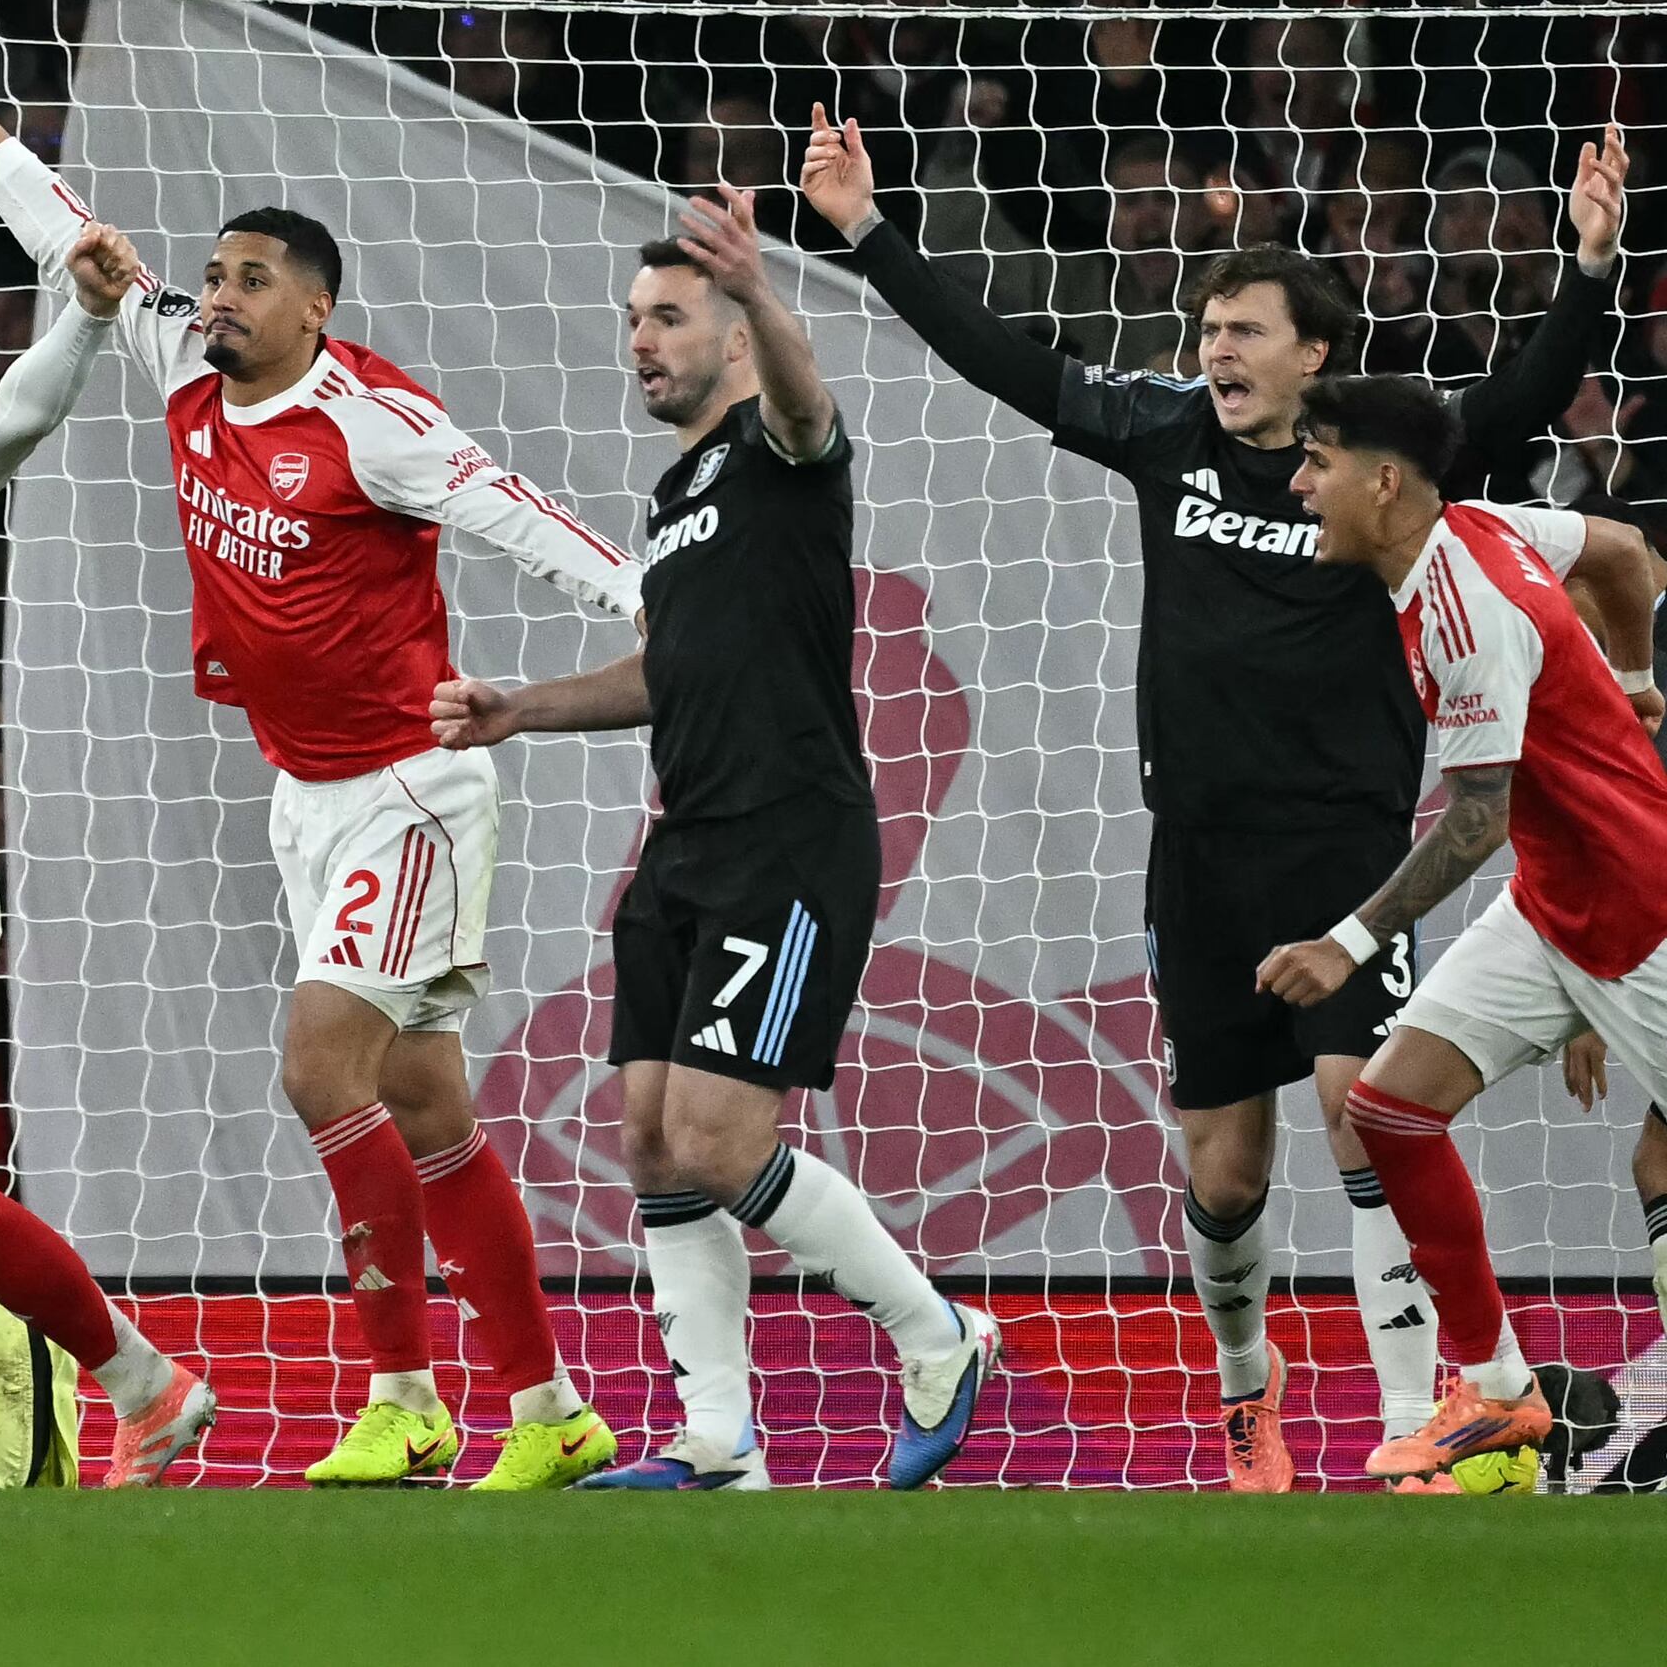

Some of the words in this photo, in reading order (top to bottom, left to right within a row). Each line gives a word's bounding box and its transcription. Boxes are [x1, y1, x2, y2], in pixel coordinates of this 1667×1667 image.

[446, 446, 480, 467] VISIT
[179, 462, 310, 550] Emirates
[187, 512, 216, 551] FLY
[217, 529, 283, 580] BETTER
[334, 869, 381, 935] 2
[711, 936, 769, 1009] 7
[1380, 932, 1412, 999] 3
